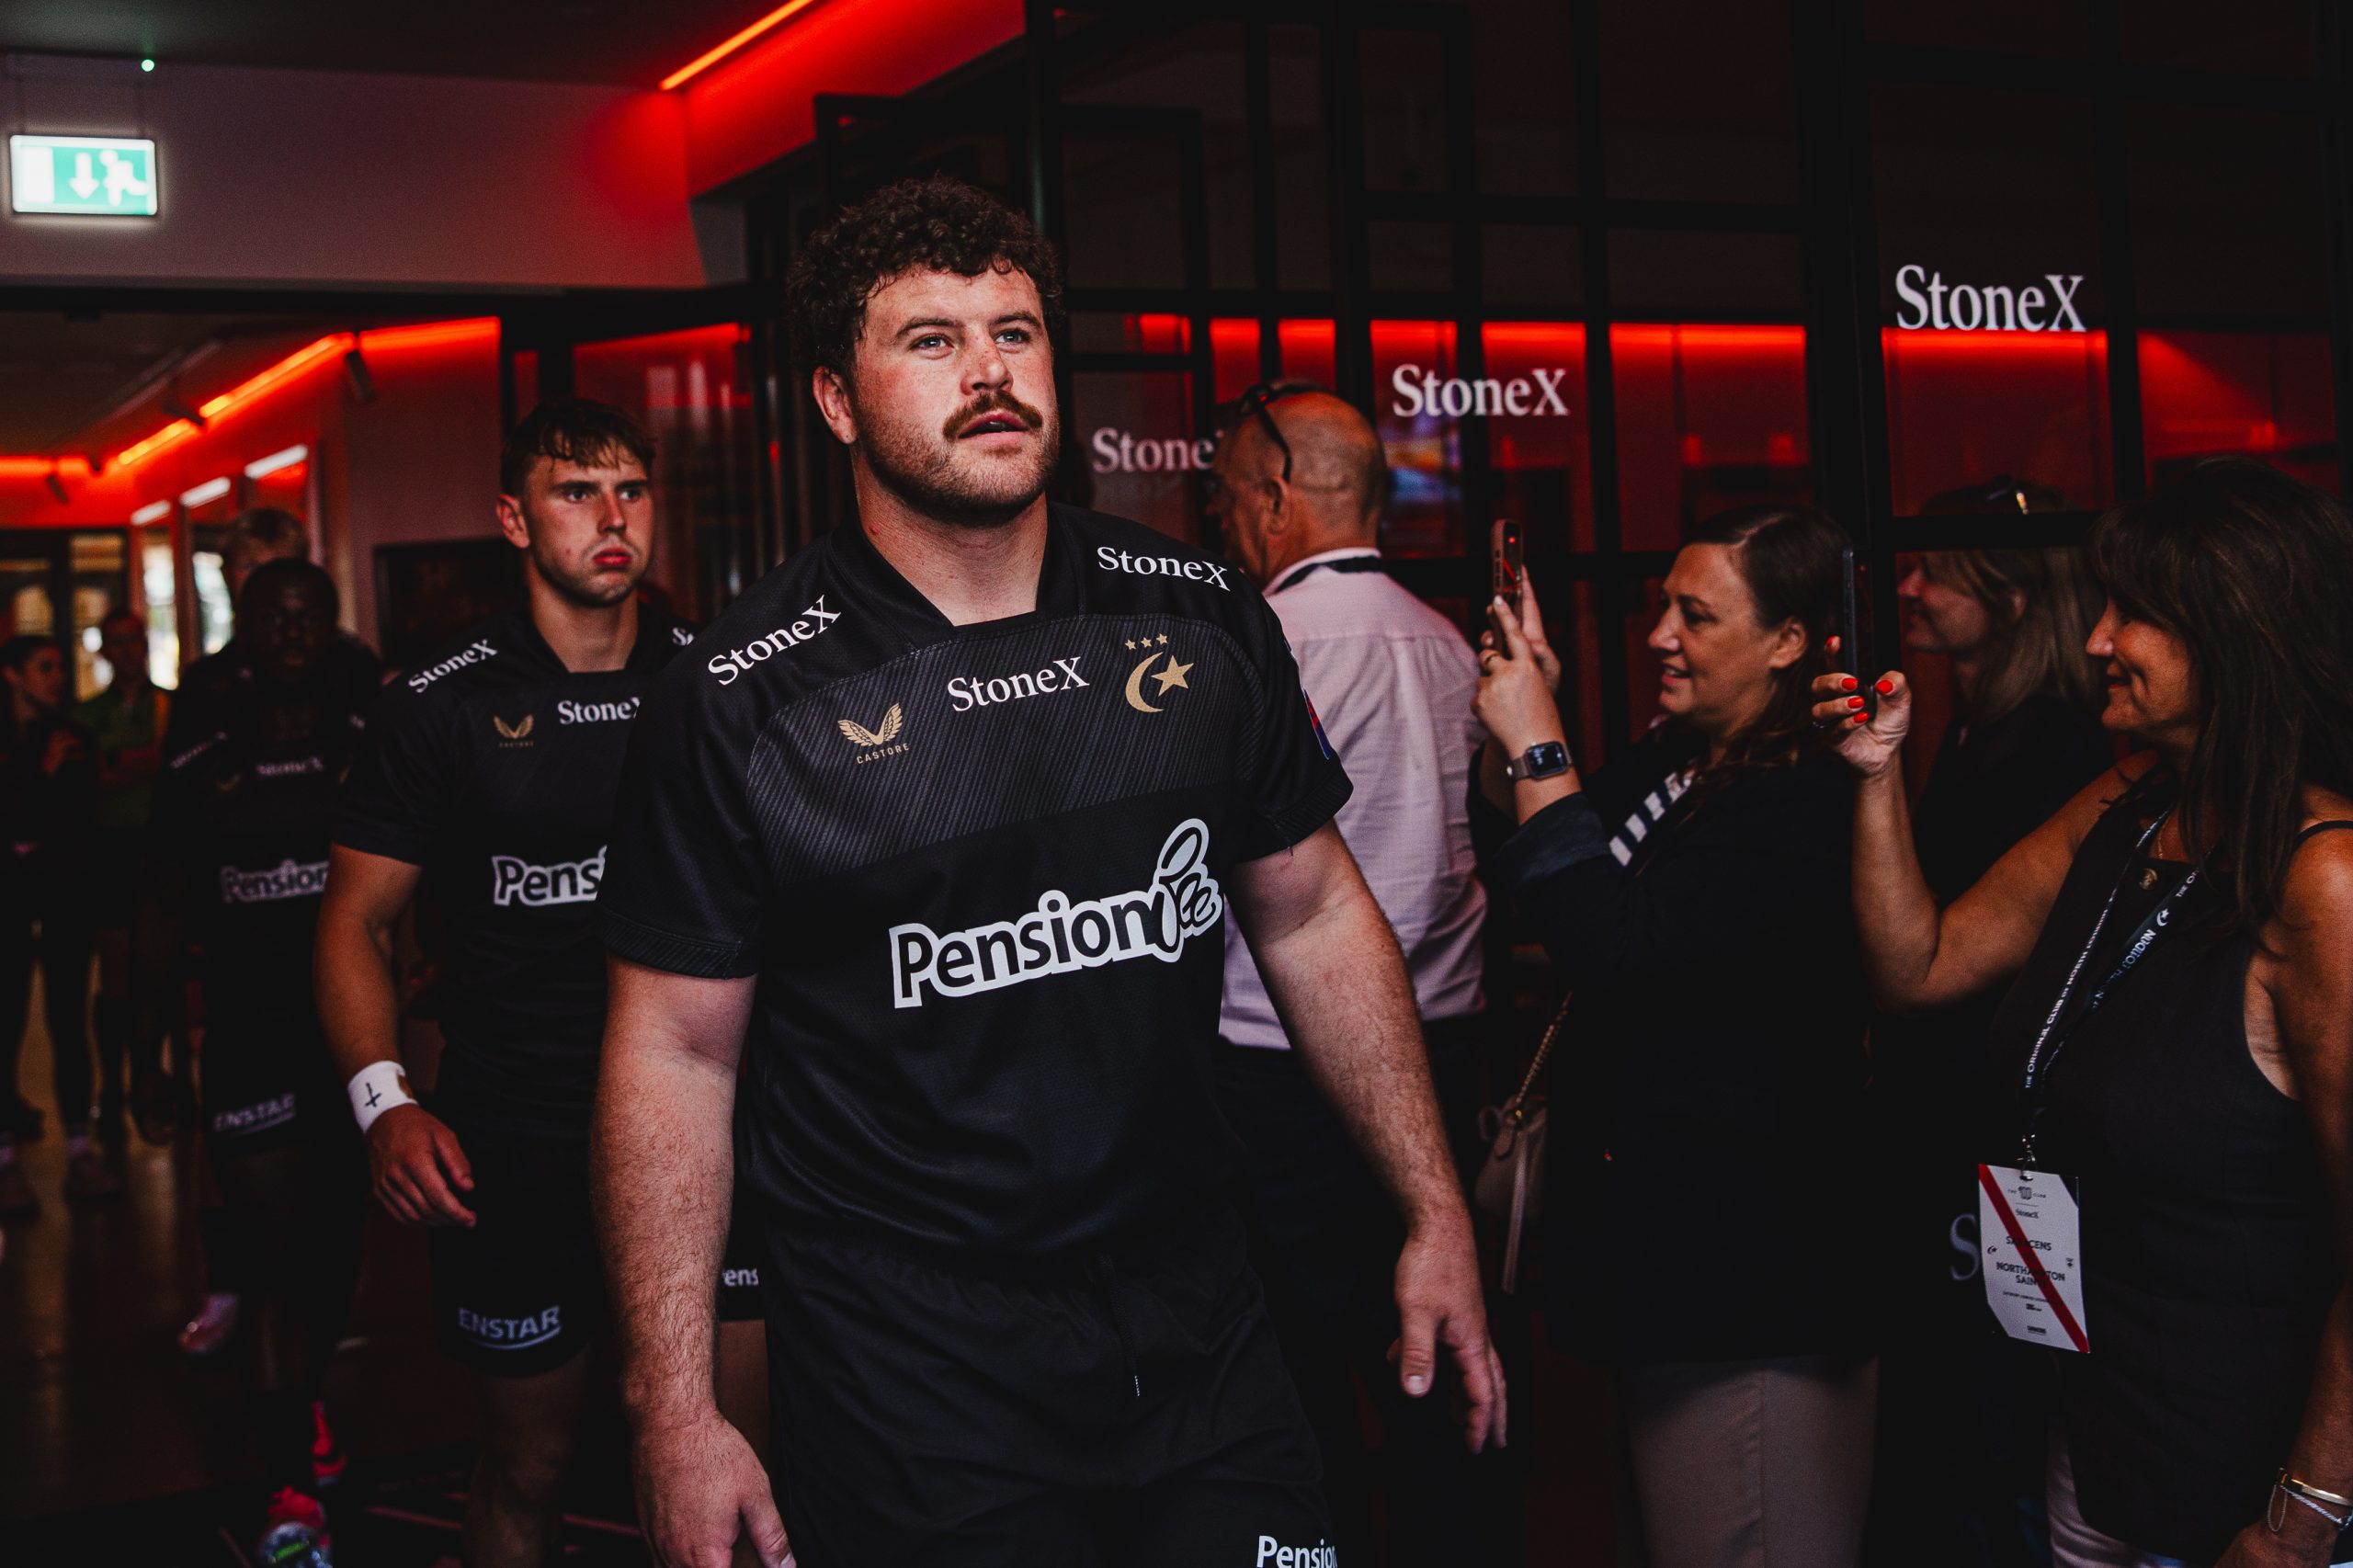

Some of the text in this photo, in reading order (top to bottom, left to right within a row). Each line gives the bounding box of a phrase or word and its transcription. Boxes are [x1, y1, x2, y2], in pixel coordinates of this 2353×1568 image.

[1895, 264, 2087, 332] StoneX
[1391, 363, 1568, 417] StoneX
[1091, 426, 1224, 474] Stone
[1097, 546, 1231, 592] StoneX
[408, 639, 498, 693] StoneX
[708, 595, 841, 686] StoneX
[947, 656, 1090, 711] StoneX
[857, 743, 909, 765] CASTORE
[722, 1268, 759, 1287] ens
[458, 1305, 560, 1340] ENSTAR
